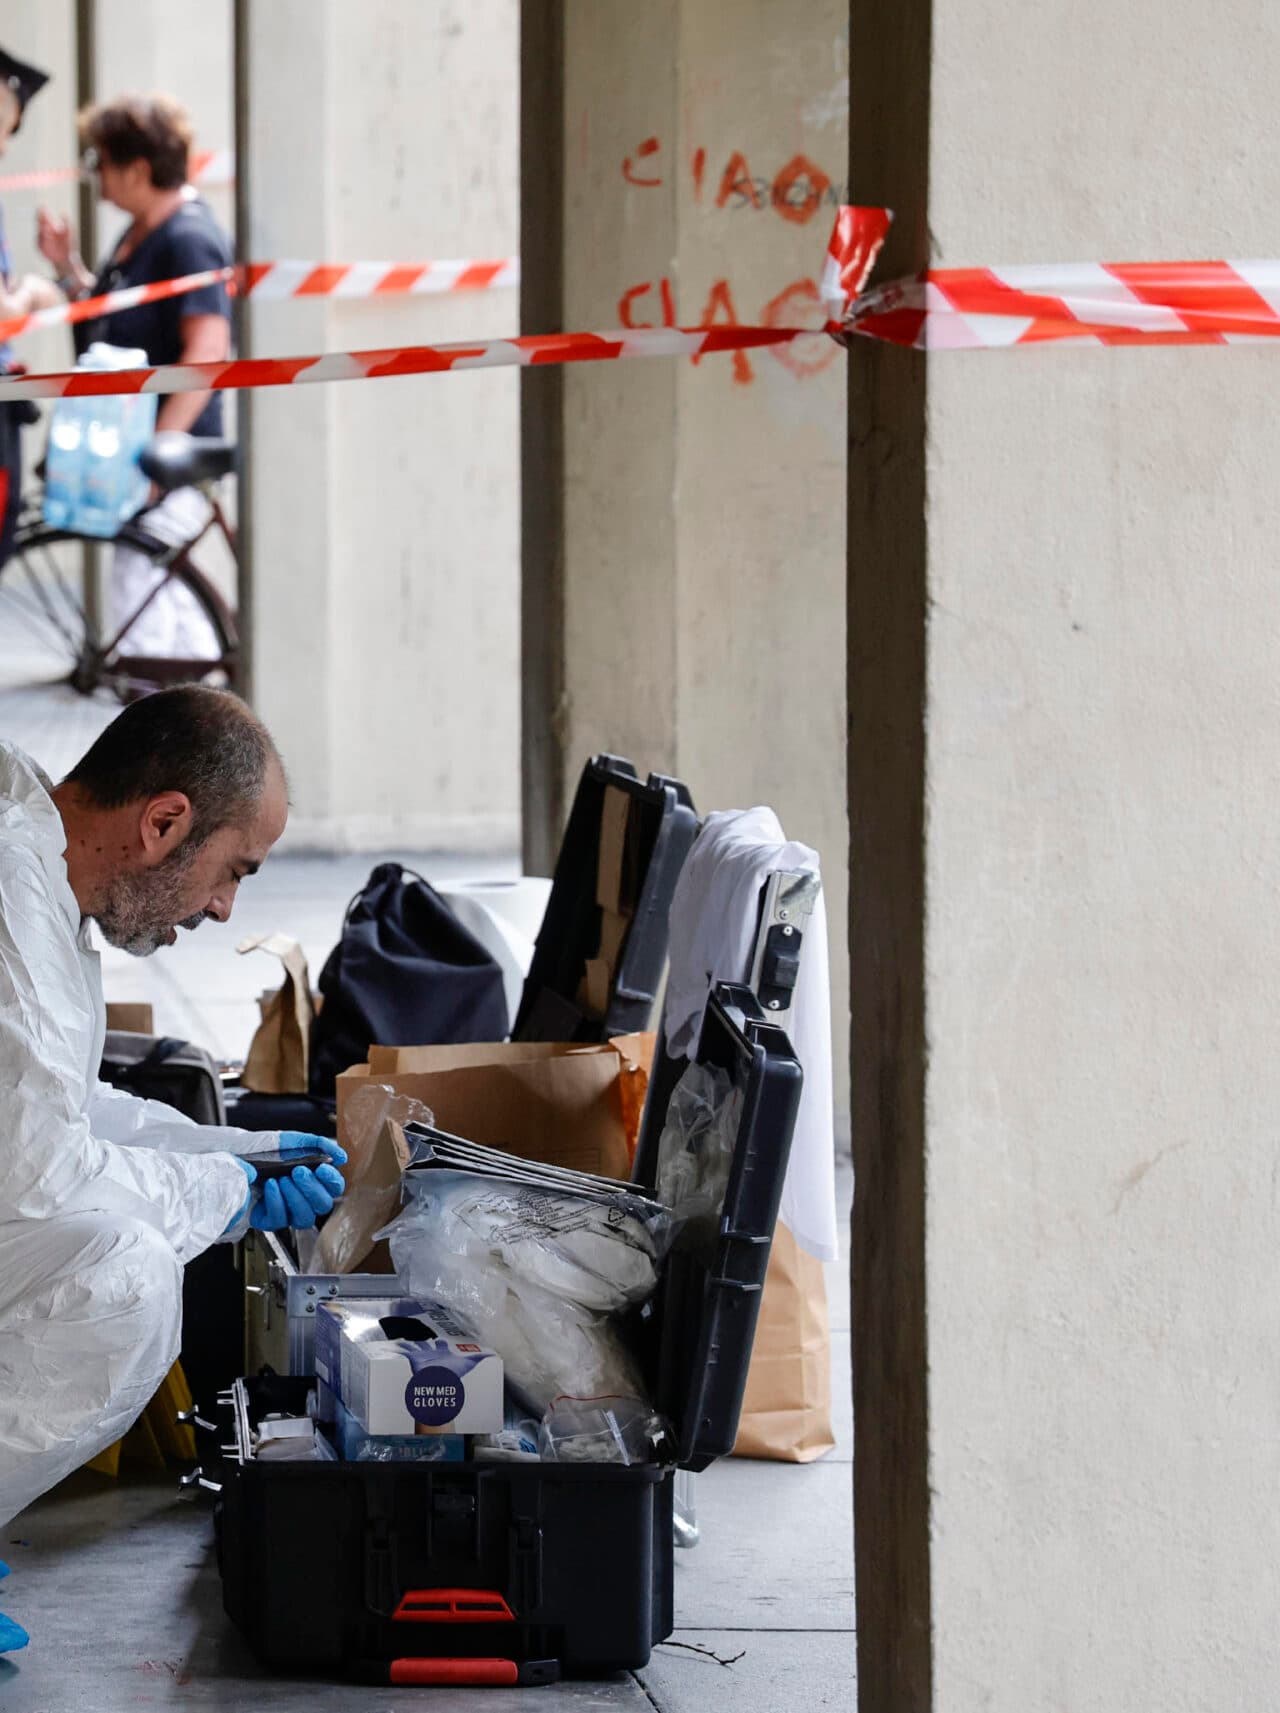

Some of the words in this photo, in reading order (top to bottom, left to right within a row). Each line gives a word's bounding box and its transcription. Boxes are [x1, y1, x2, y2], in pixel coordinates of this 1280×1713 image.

[621, 136, 832, 226] CIAO
[414, 1386, 435, 1396] NEW
[436, 1386, 456, 1396] MED
[413, 1397, 456, 1407] GLOVES
